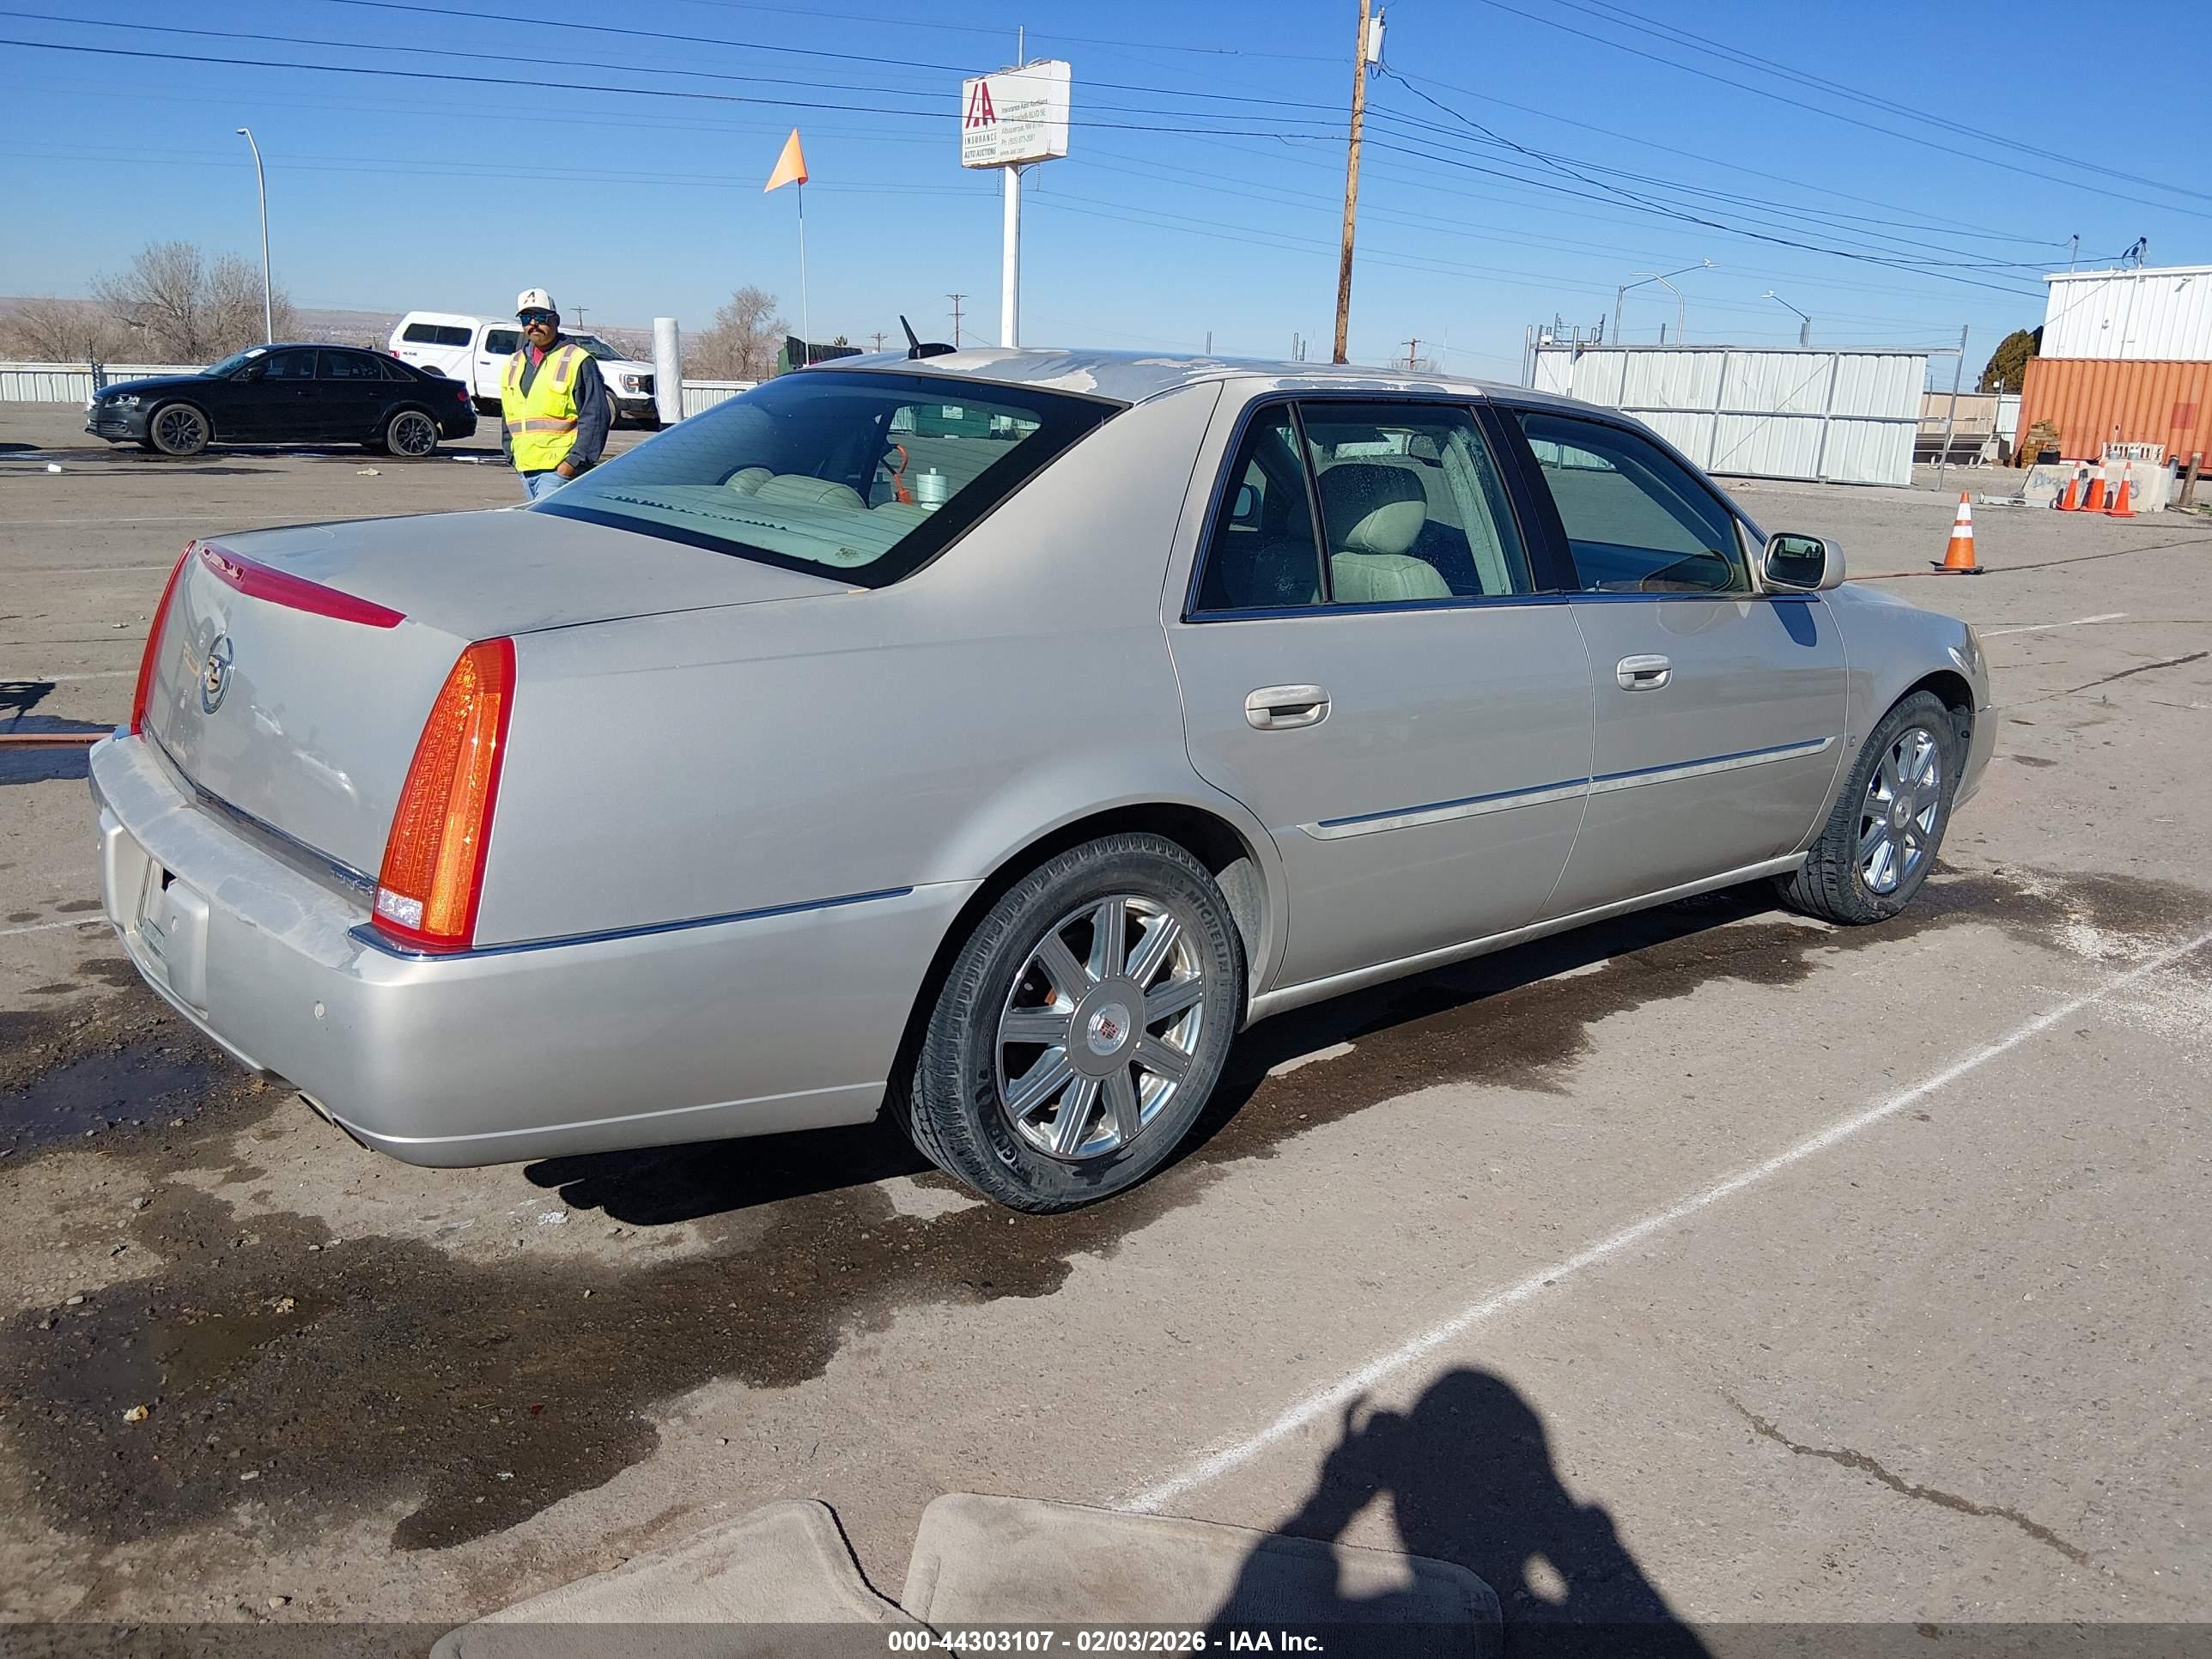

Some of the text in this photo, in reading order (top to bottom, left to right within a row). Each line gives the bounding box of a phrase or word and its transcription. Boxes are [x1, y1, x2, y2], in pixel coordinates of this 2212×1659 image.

[964, 132, 997, 145] INSURANCE
[963, 149, 976, 159] AUTO
[1183, 890, 1231, 974] MICHELIN
